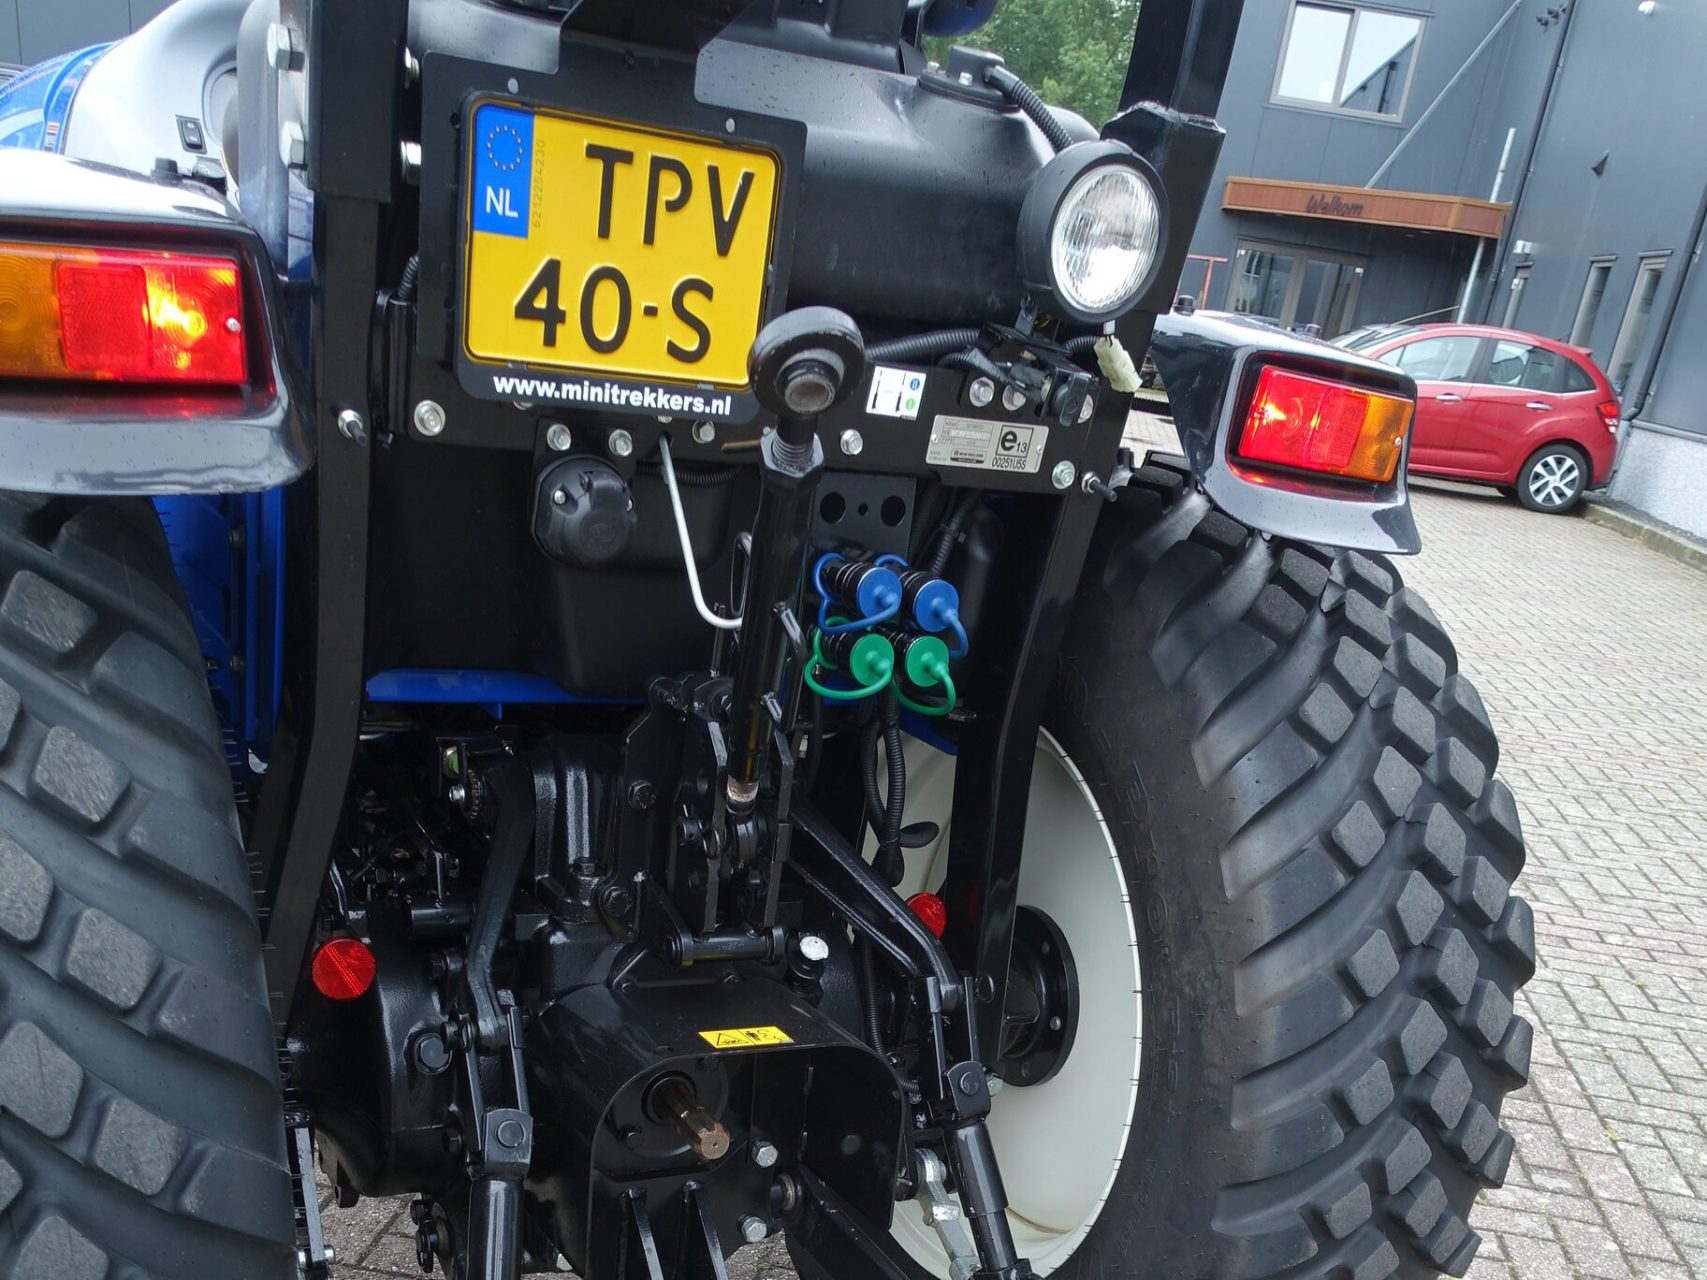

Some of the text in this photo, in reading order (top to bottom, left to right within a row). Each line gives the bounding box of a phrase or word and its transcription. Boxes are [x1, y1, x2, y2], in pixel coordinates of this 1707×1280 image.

[486, 186, 518, 218] NL
[585, 142, 755, 257] TPV
[513, 257, 714, 363] 40-S
[493, 375, 732, 416] www.minitrekkers.nl
